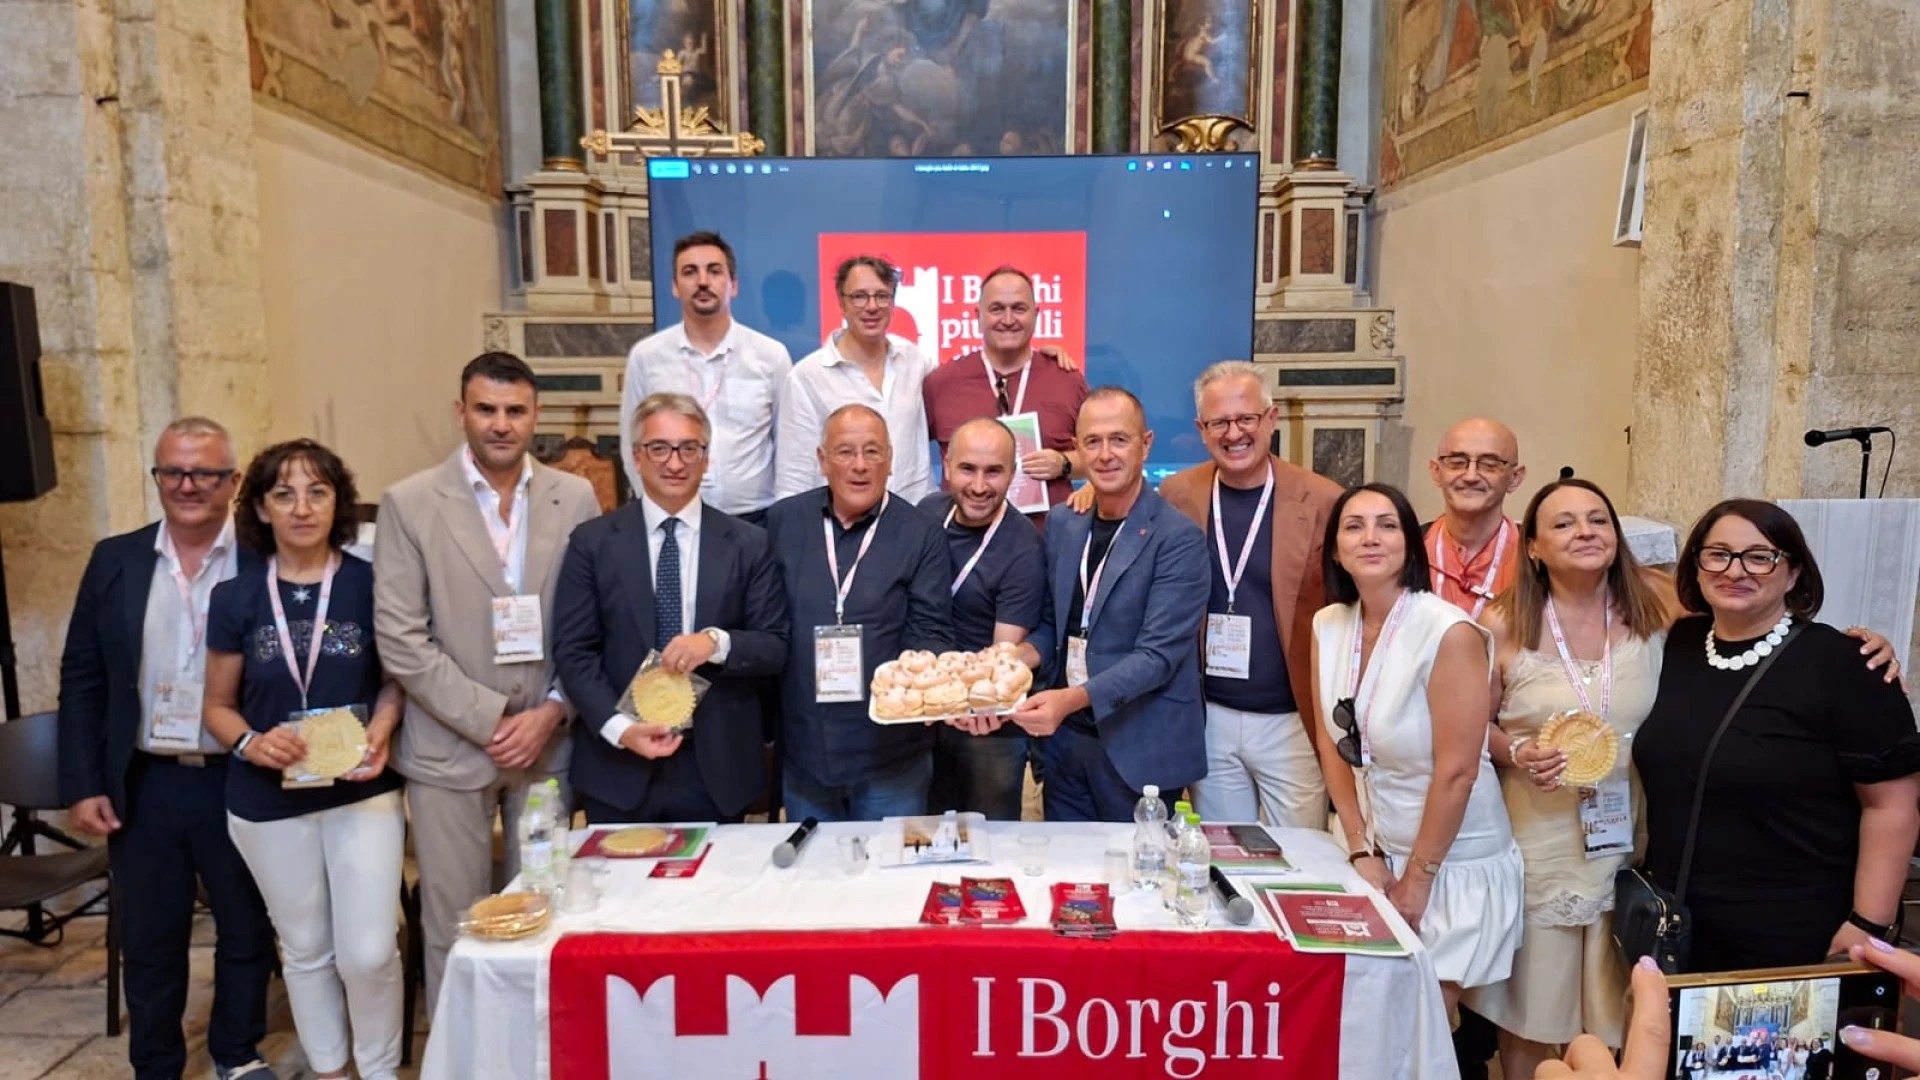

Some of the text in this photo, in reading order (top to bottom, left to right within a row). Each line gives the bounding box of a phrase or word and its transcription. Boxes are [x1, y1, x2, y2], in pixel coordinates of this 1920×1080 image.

[942, 273, 1063, 304] I Bhi
[1033, 310, 1064, 339] lli
[972, 977, 1284, 1079] I Borghi
